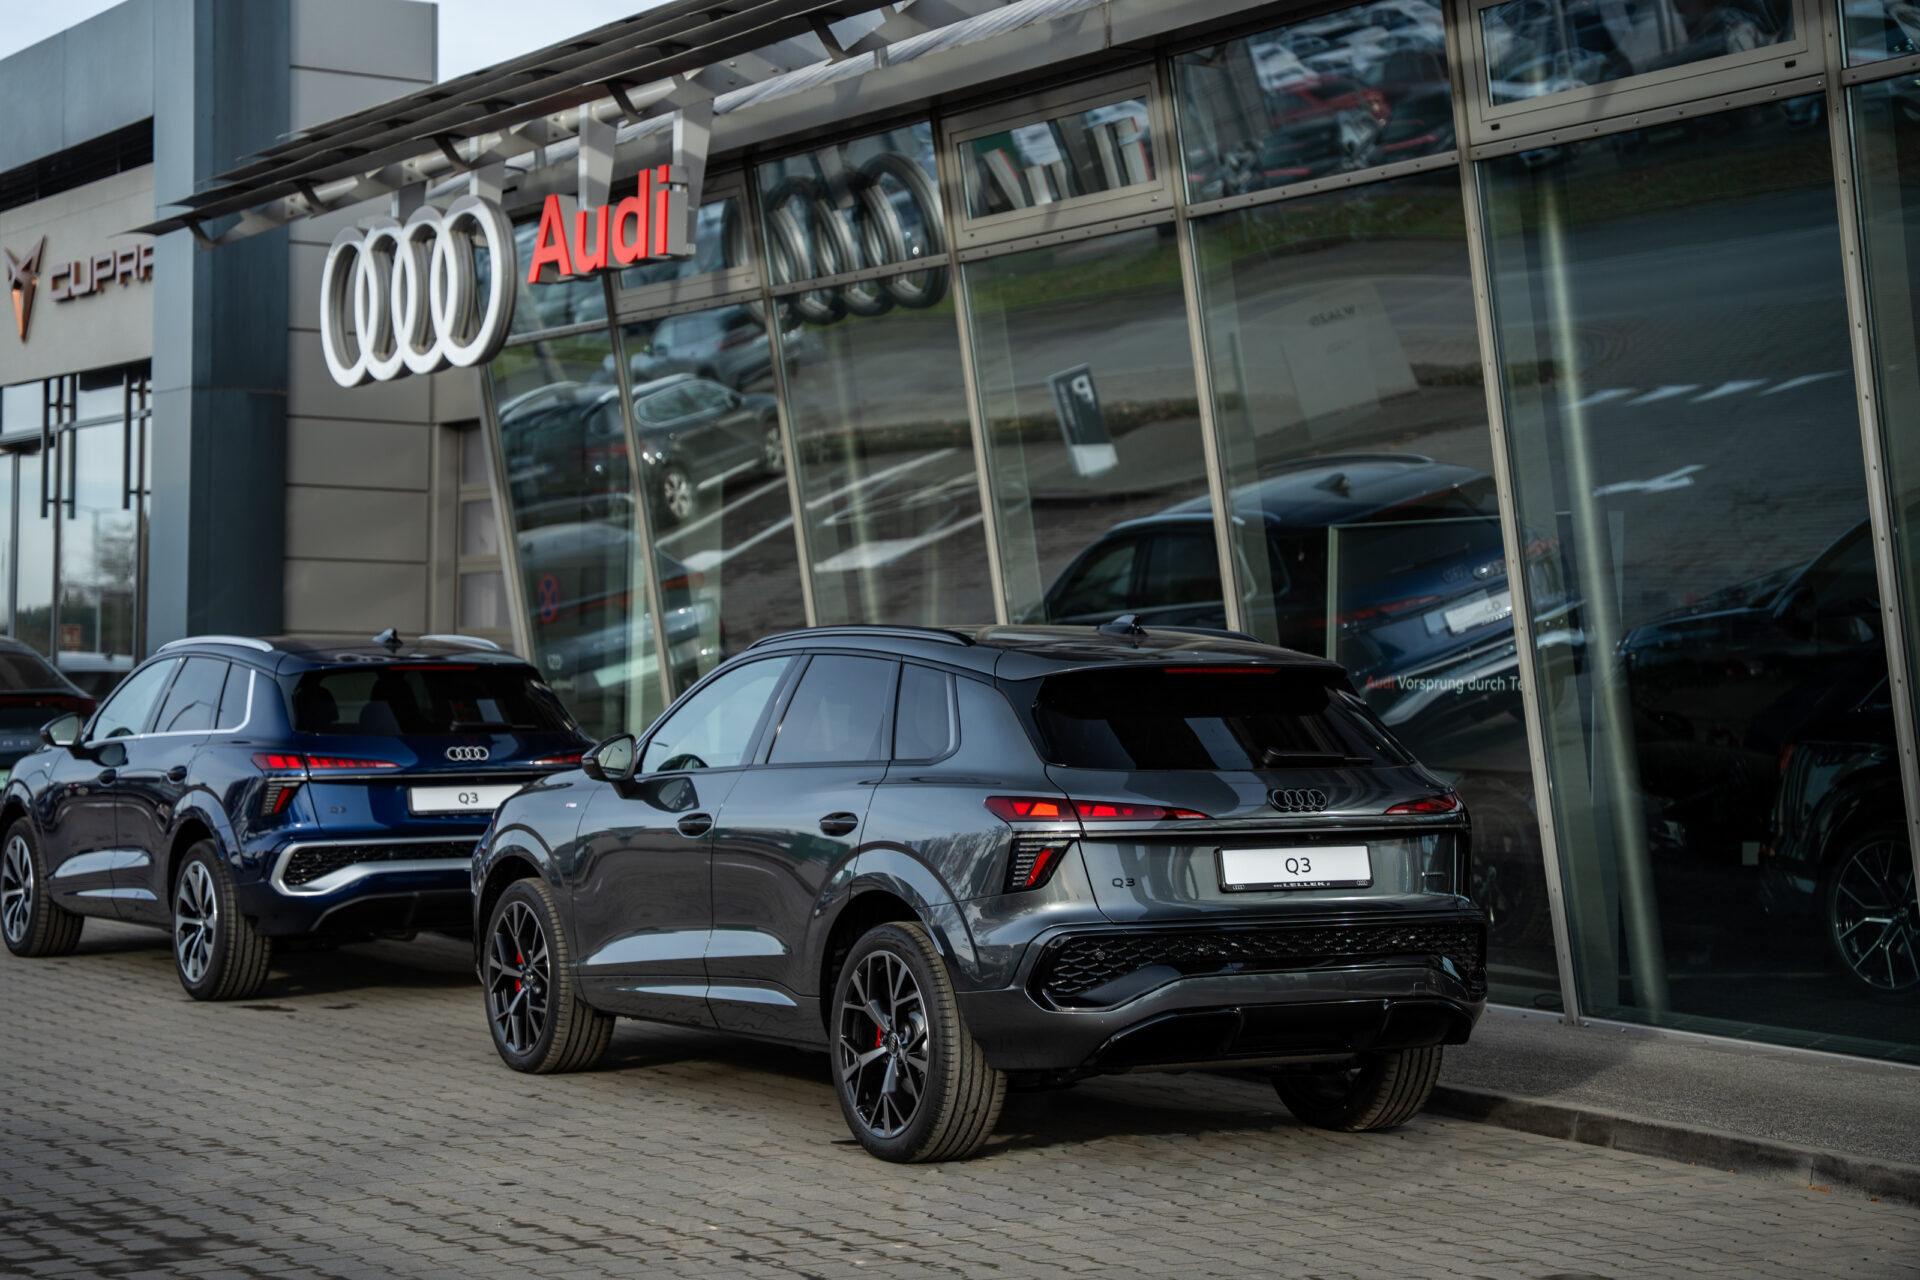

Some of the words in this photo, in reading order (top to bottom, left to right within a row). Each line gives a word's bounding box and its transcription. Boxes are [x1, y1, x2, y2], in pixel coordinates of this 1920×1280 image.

[527, 164, 669, 284] Audi
[1365, 675, 1395, 689] Audi
[1397, 676, 1464, 694] Vorsprung
[1467, 675, 1506, 691] durch
[458, 792, 479, 805] Q3
[1285, 857, 1312, 875] Q3
[1111, 877, 1136, 888] Q3
